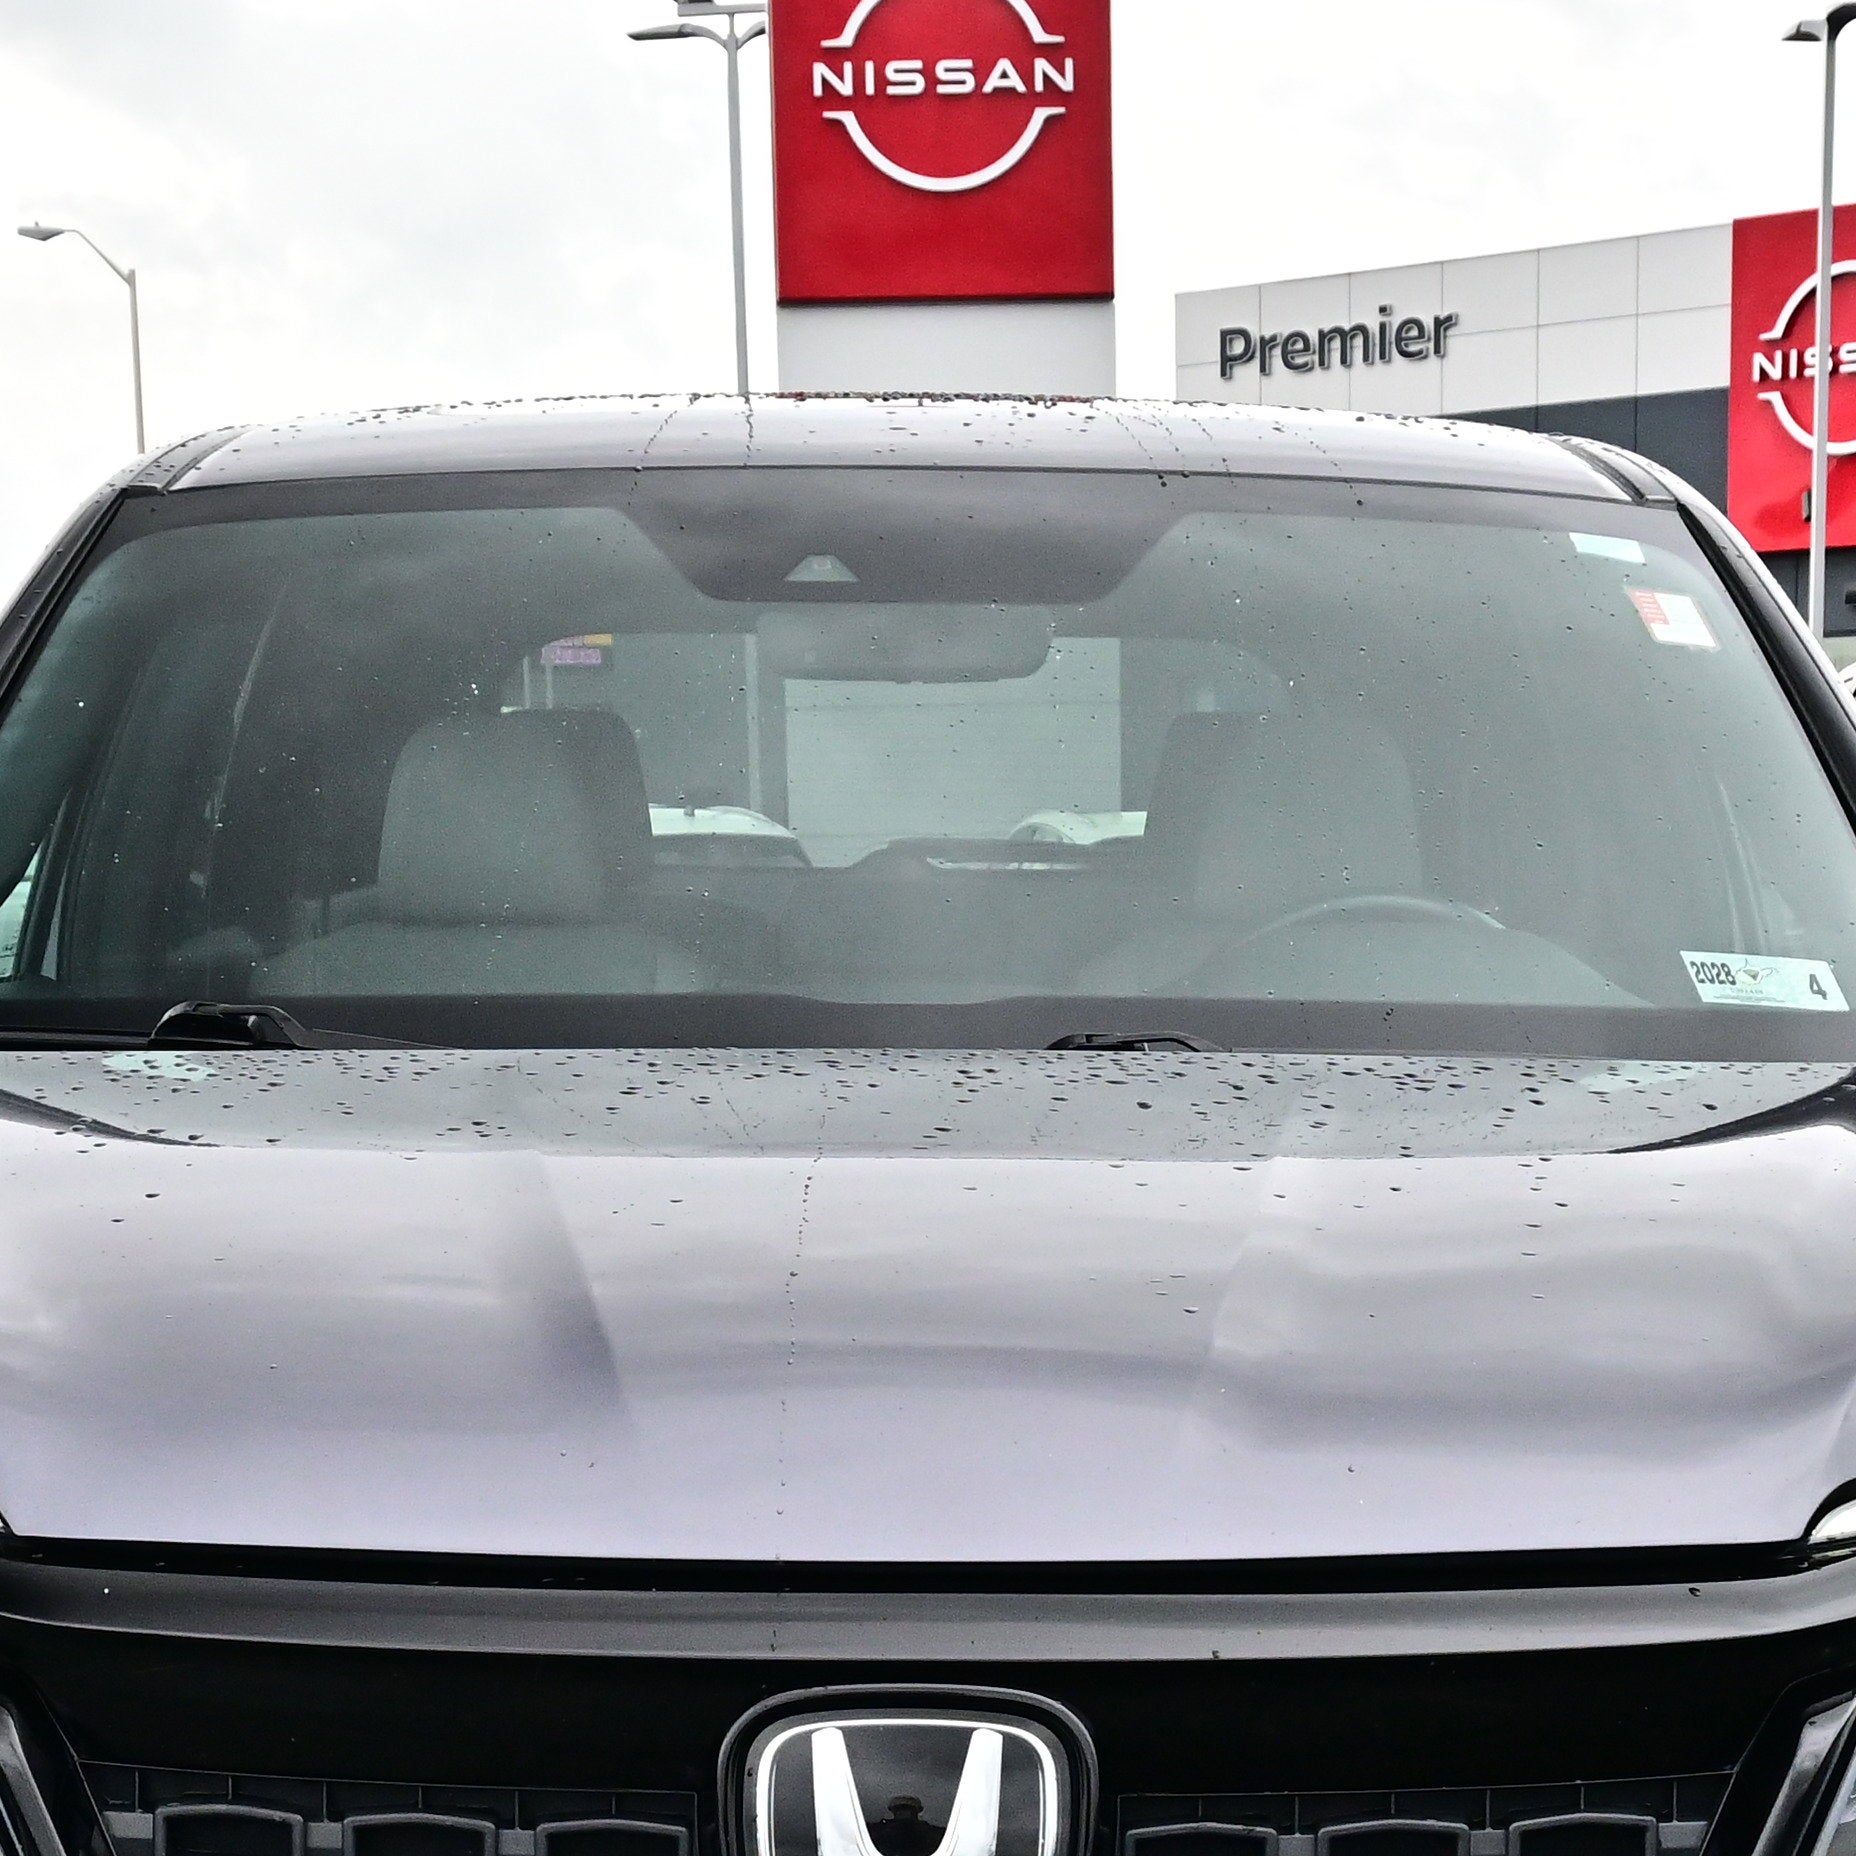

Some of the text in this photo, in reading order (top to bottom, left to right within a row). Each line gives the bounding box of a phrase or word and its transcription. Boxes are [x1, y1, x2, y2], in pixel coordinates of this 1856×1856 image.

[812, 57, 1075, 97] NISSAN
[1219, 304, 1458, 380] Premier
[1689, 960, 1737, 986] 2028
[1809, 973, 1828, 1001] 4
